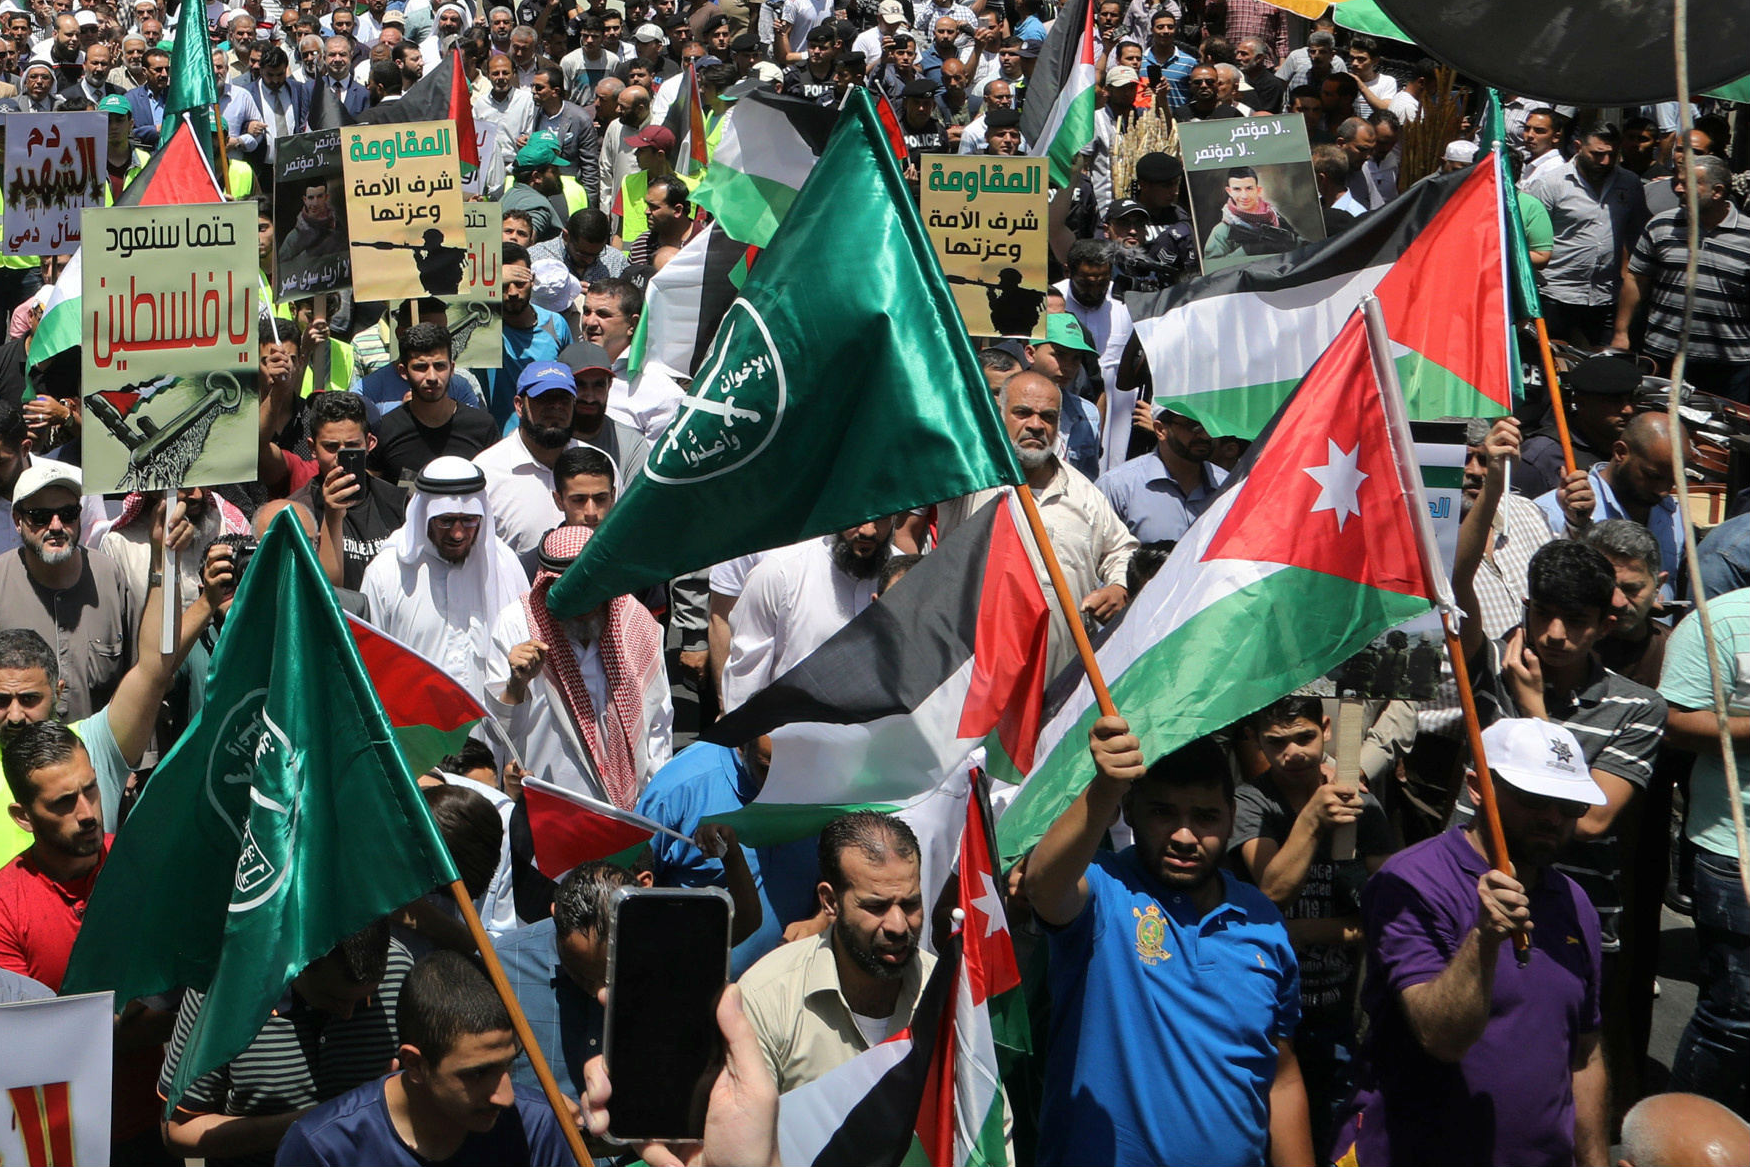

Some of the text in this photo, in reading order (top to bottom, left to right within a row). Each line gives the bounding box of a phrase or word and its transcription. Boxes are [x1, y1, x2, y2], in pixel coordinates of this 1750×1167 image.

[27, 124, 61, 159] دم
[1230, 121, 1270, 143] مؤتمر
[350, 128, 452, 170] المقاومة
[1194, 143, 1234, 165] مؤتمر
[8, 136, 105, 212] الشهيد
[283, 157, 314, 177] مؤتمر
[354, 172, 401, 198] الأمة
[407, 170, 454, 199] شرف
[928, 162, 1041, 203] المقاومة
[370, 202, 441, 226] وعزتها
[928, 205, 1039, 236] شرف الأمة
[8, 224, 41, 253] دمي
[105, 215, 236, 258] حتما سنعود
[944, 237, 1022, 263] وعزتها
[92, 270, 251, 371] يا فلسطين
